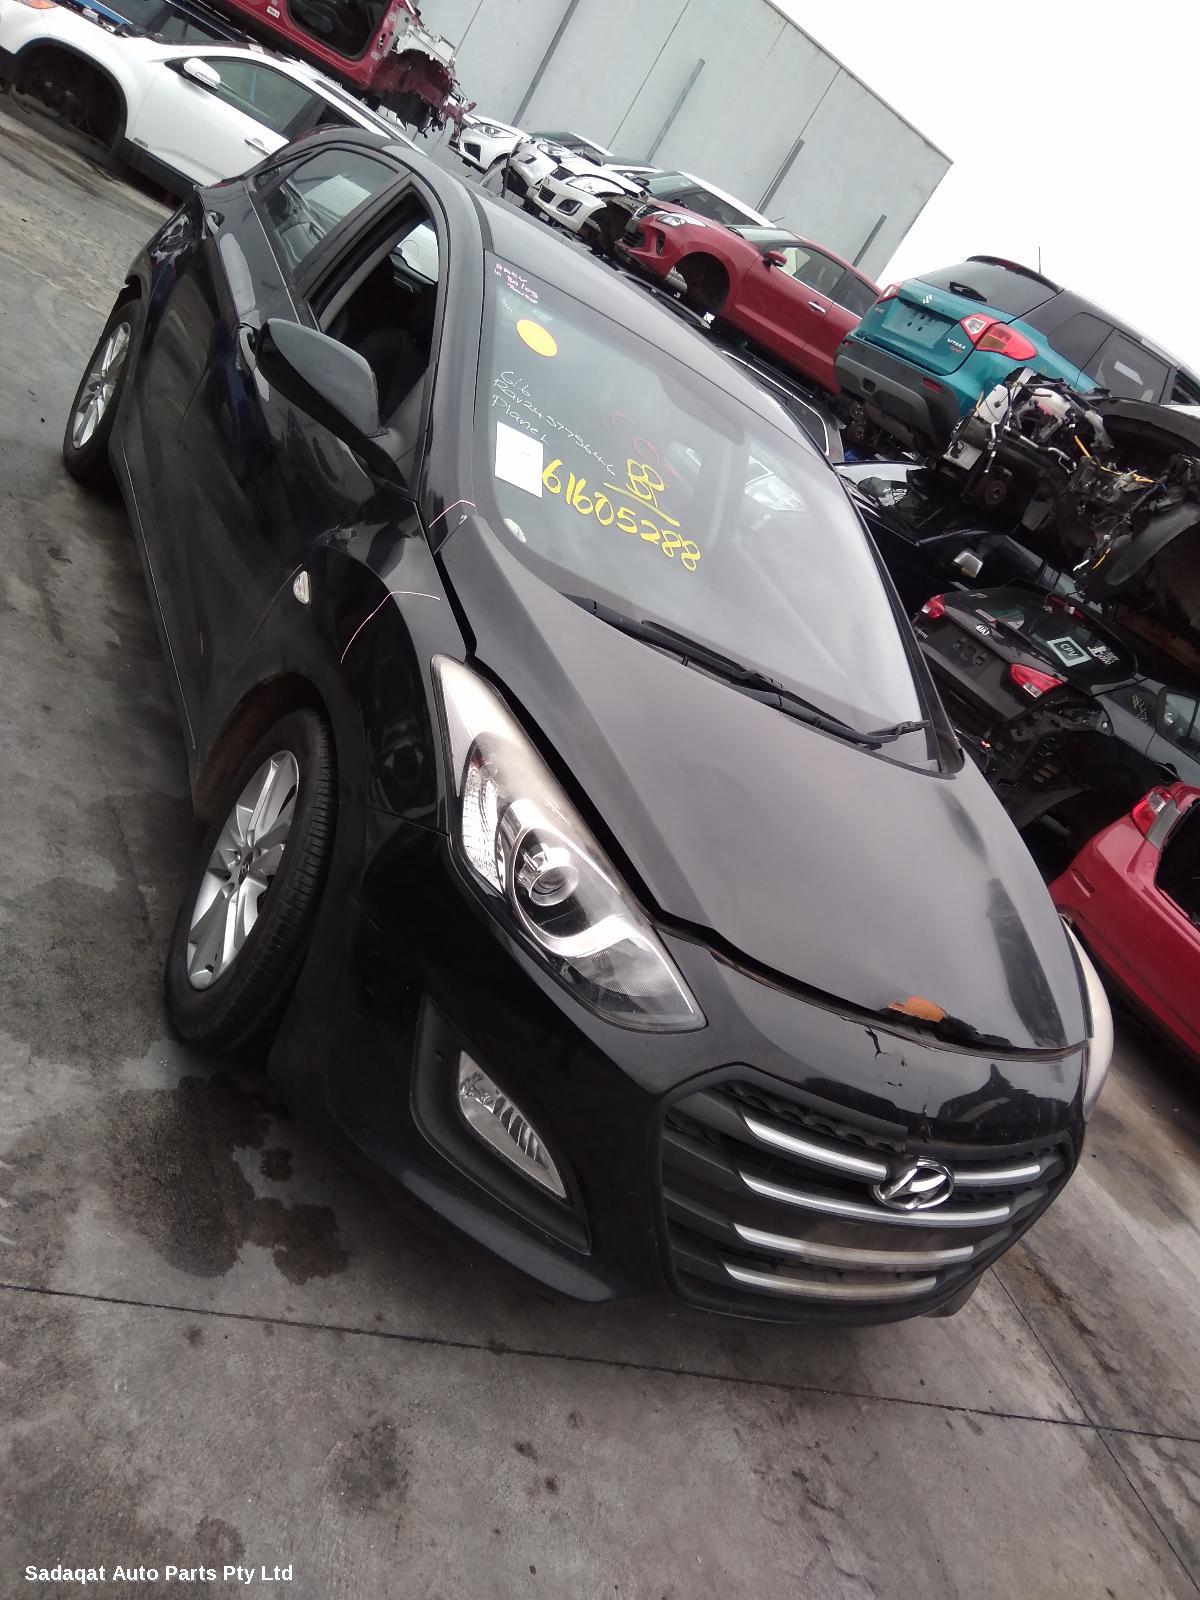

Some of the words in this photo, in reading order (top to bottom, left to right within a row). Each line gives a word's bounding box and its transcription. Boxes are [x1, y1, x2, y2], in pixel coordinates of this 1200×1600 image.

[542, 458, 701, 571] 61605288
[975, 624, 989, 635] KIA
[1061, 643, 1079, 656] CPV
